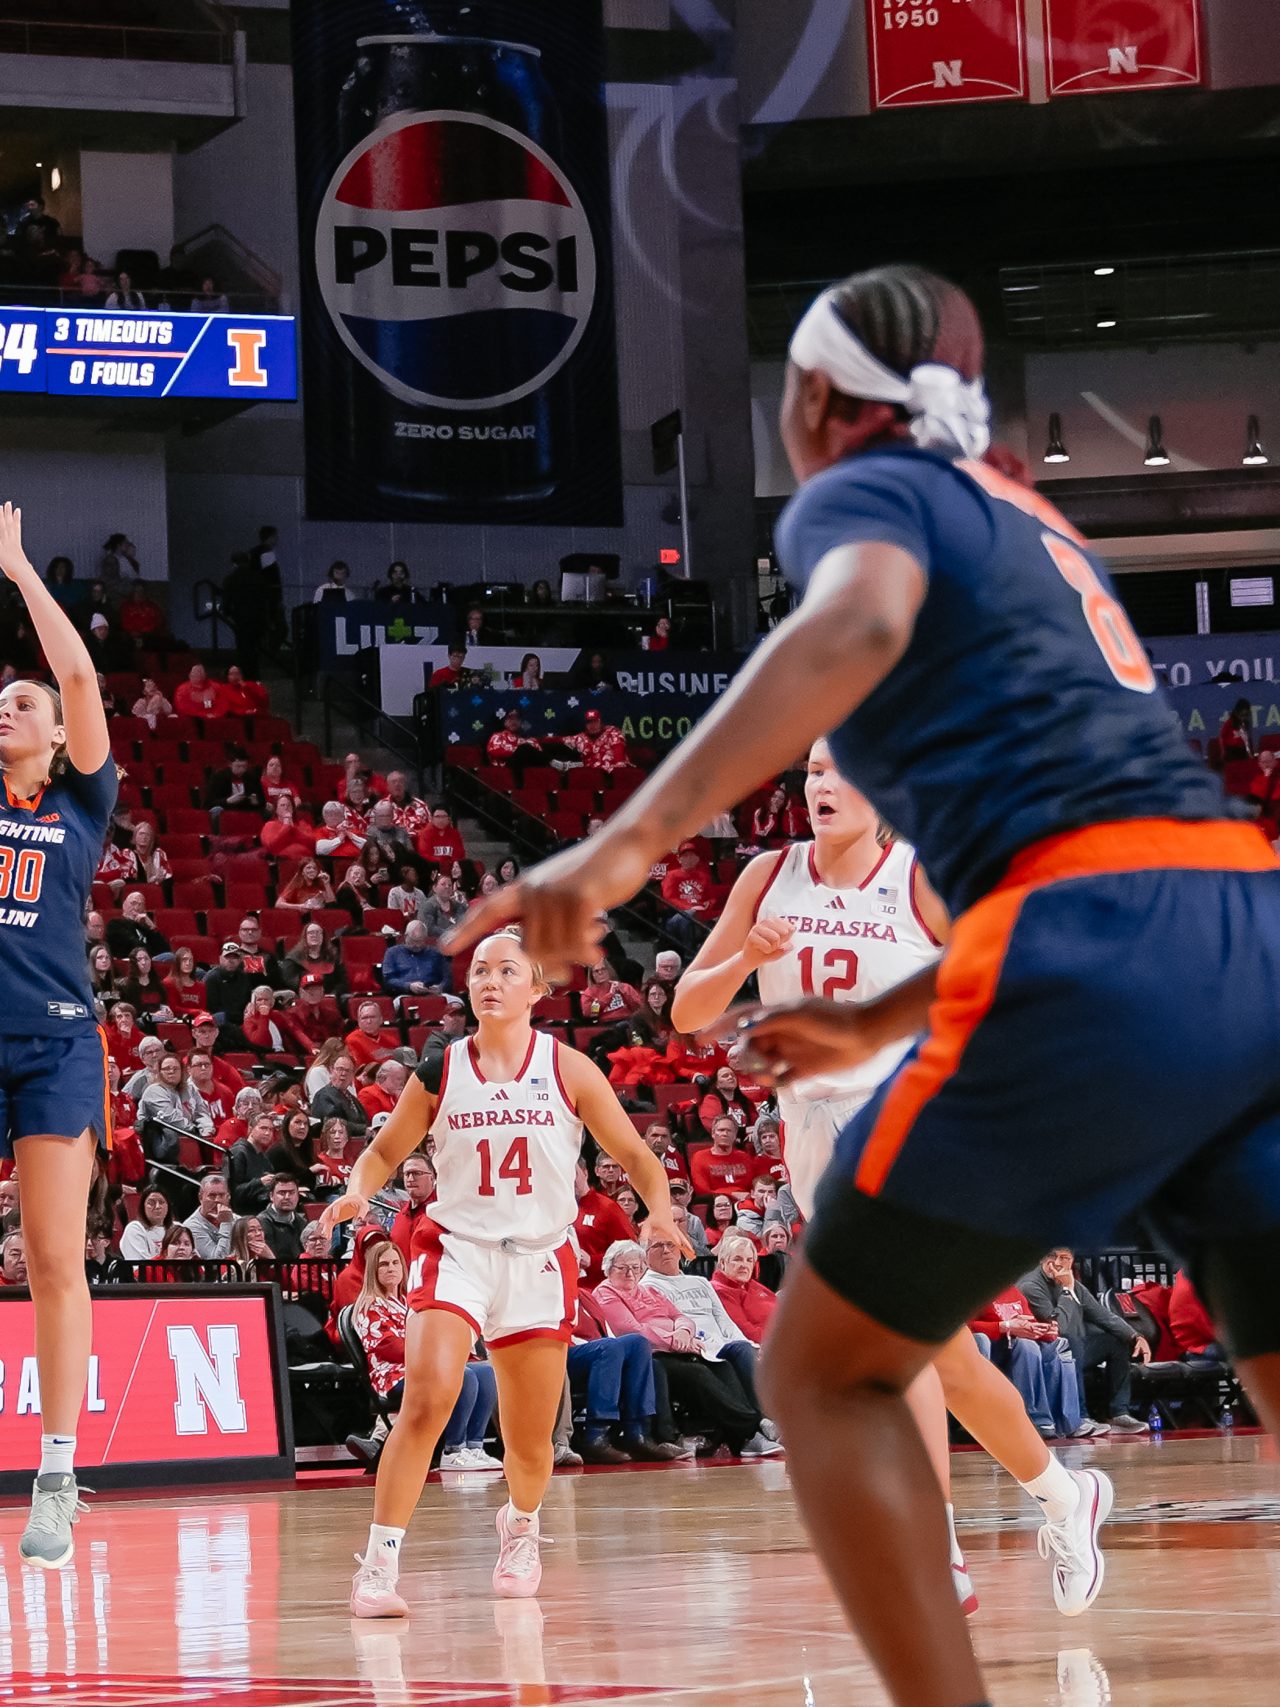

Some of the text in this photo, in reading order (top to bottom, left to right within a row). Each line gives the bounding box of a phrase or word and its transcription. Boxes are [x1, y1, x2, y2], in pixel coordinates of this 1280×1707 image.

[883, 8, 940, 31] 1950
[932, 59, 964, 88] N
[1107, 46, 1139, 74] N
[333, 224, 579, 293] PEPSI
[53, 318, 173, 345] 3 TIMEOUTS
[69, 361, 155, 387] 0 FOULS
[394, 421, 537, 441] ZERO SUGAR
[1152, 661, 1191, 688] O
[778, 914, 898, 944] BRASKA
[797, 946, 859, 1002] 12
[447, 1108, 555, 1131] NEBRASKA
[476, 1136, 533, 1197] 14
[583, 1214, 595, 1227] N
[166, 1323, 248, 1437] N
